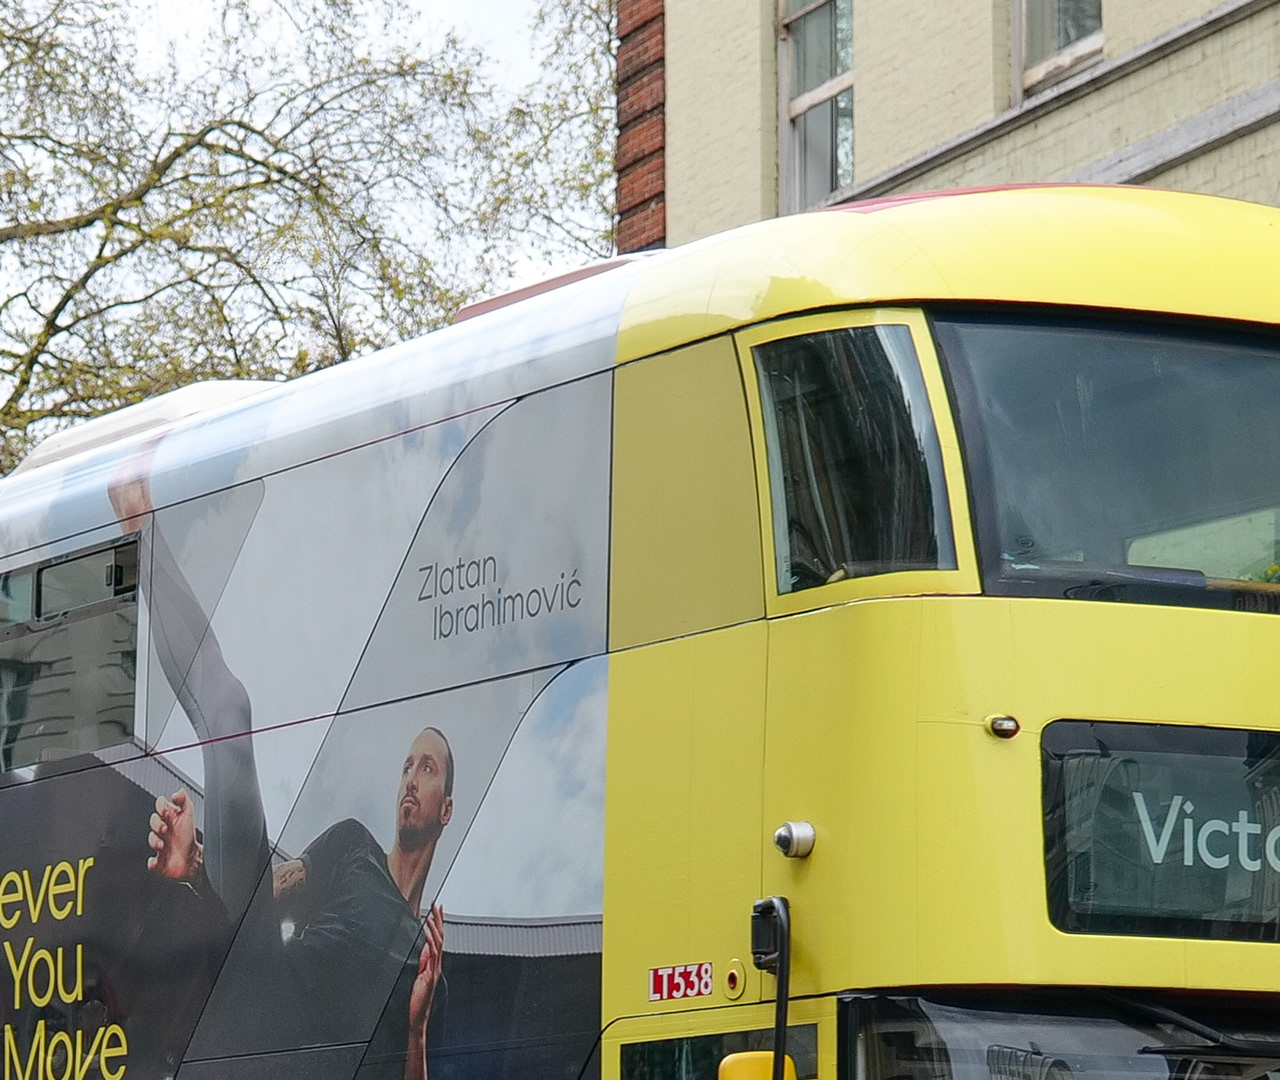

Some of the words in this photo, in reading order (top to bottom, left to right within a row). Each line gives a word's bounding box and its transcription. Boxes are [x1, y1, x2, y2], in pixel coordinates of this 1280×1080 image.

[418, 555, 497, 602] Zlatan
[433, 568, 582, 641] Ibrahimović
[3, 936, 84, 1010] You
[649, 963, 713, 1001] LT538
